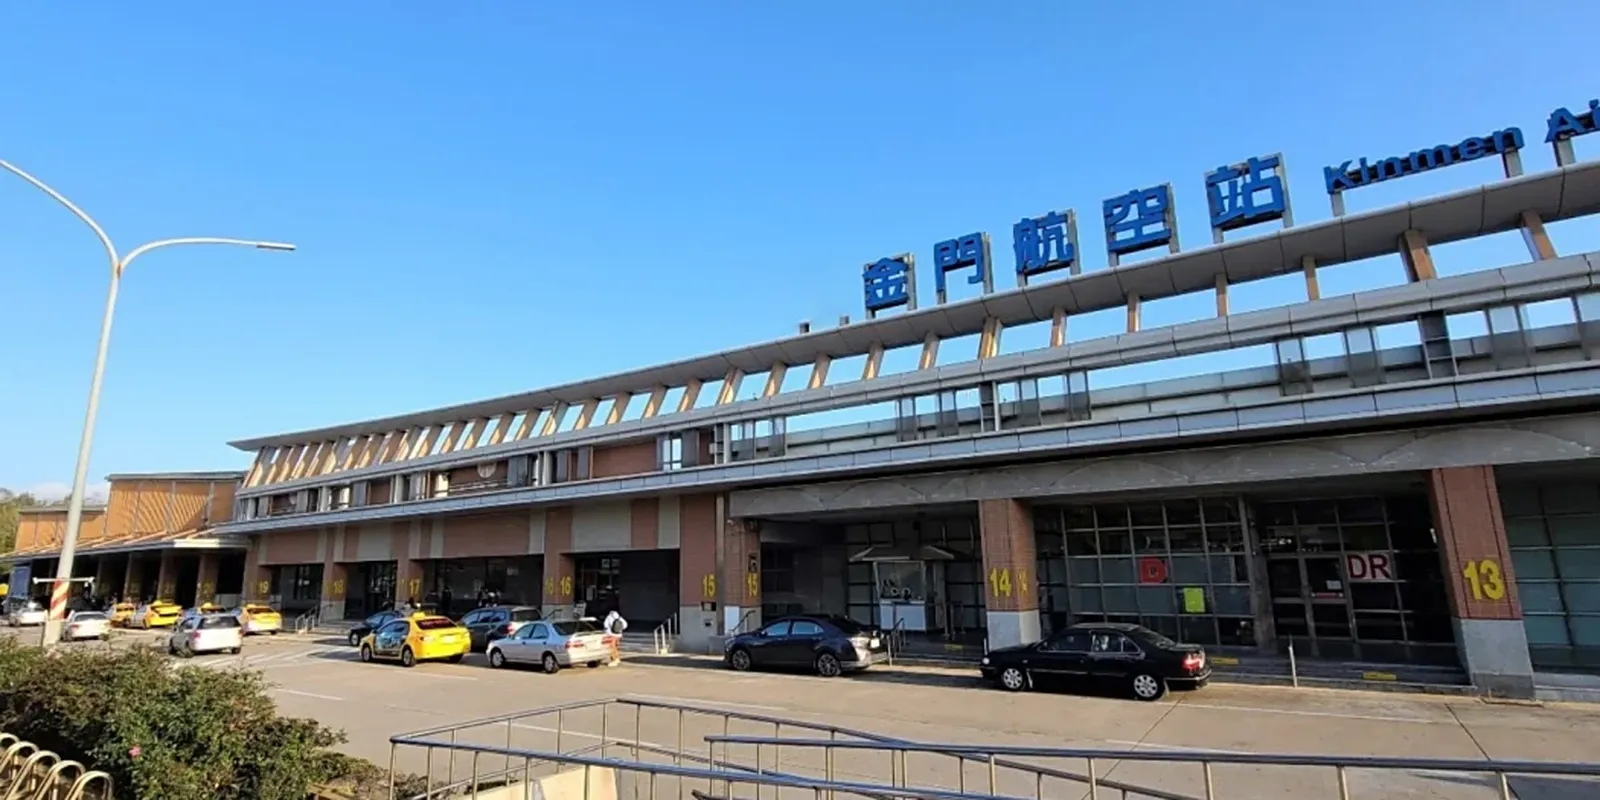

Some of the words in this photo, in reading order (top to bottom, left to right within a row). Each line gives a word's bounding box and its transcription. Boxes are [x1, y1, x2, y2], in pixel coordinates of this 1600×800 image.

[1323, 126, 1525, 195] Kinmen
[862, 155, 1286, 311] 金門航空站
[1347, 554, 1391, 580] DR
[1463, 559, 1505, 600] 13
[257, 580, 270, 596] 19
[409, 577, 421, 596] 17
[560, 576, 572, 597] 16
[702, 574, 717, 598] 15
[746, 573, 759, 598] 15
[989, 568, 1013, 598] 14
